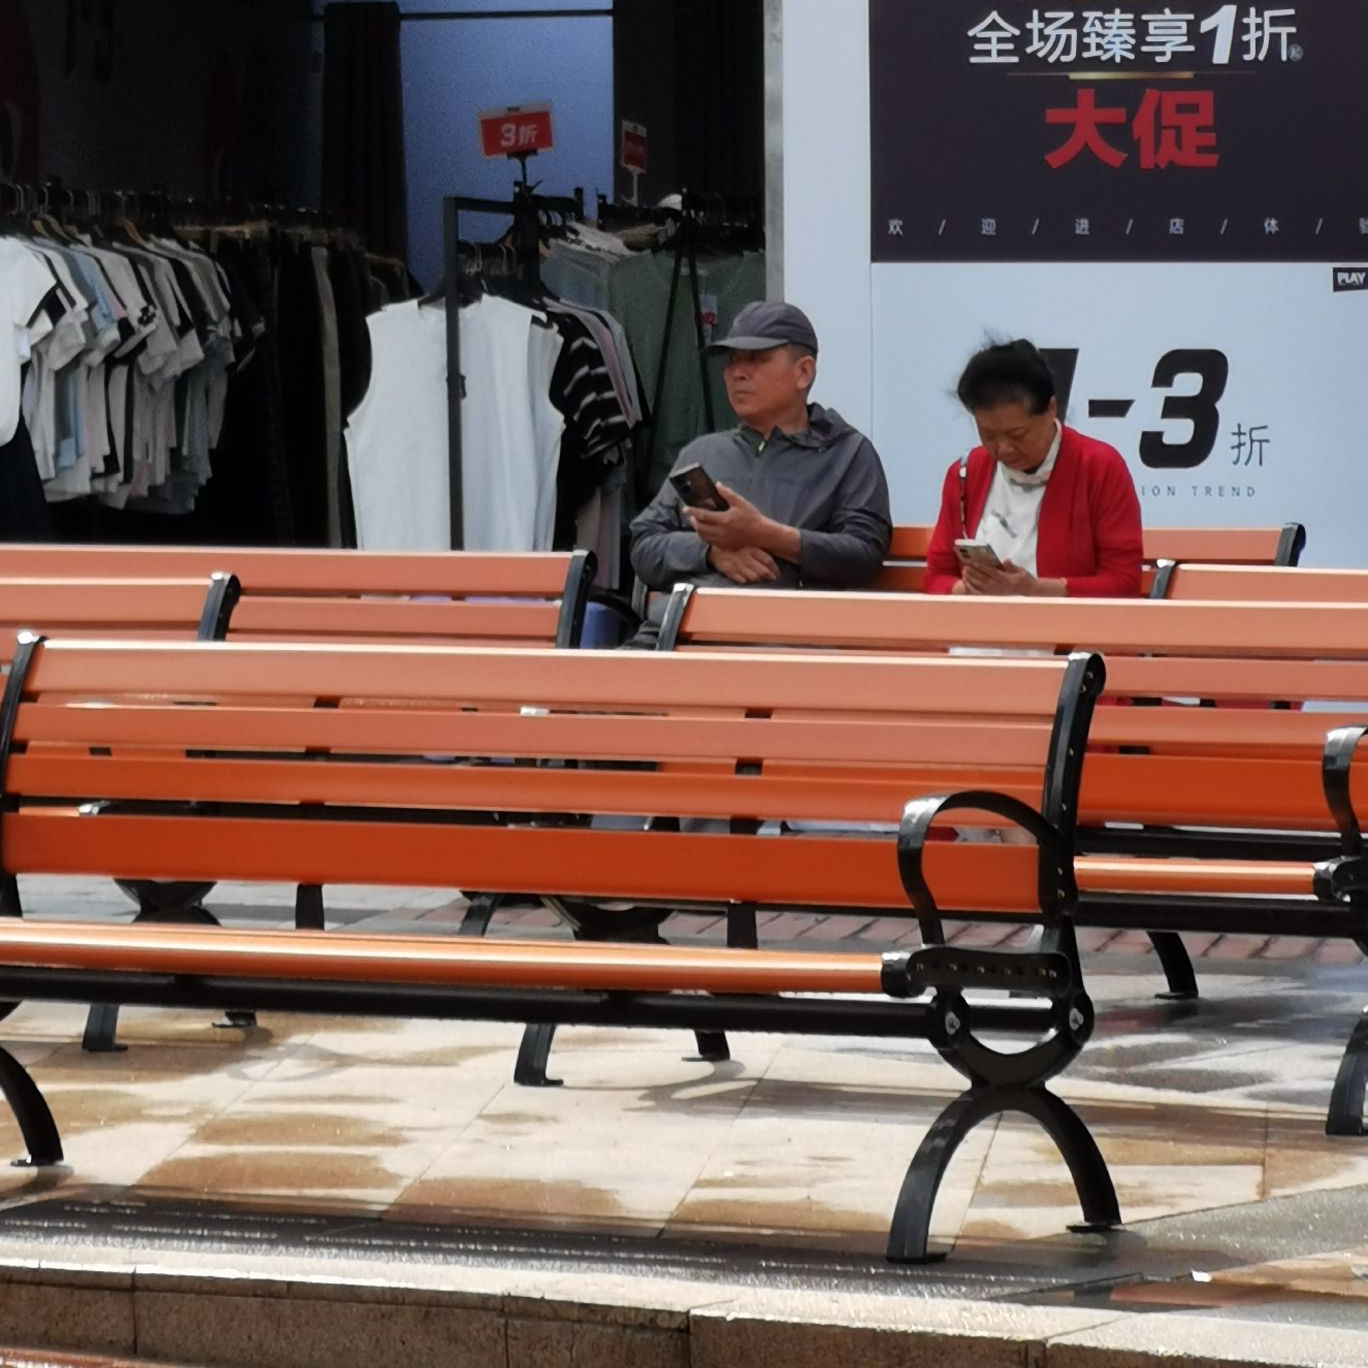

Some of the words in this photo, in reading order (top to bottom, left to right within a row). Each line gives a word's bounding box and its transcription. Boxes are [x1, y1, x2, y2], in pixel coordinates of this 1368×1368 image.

[499, 122, 538, 148] 3折
[1043, 88, 1221, 170] 大促
[1336, 271, 1367, 286] PLAY
[1230, 422, 1272, 468] 折
[1191, 485, 1257, 498] TREND
